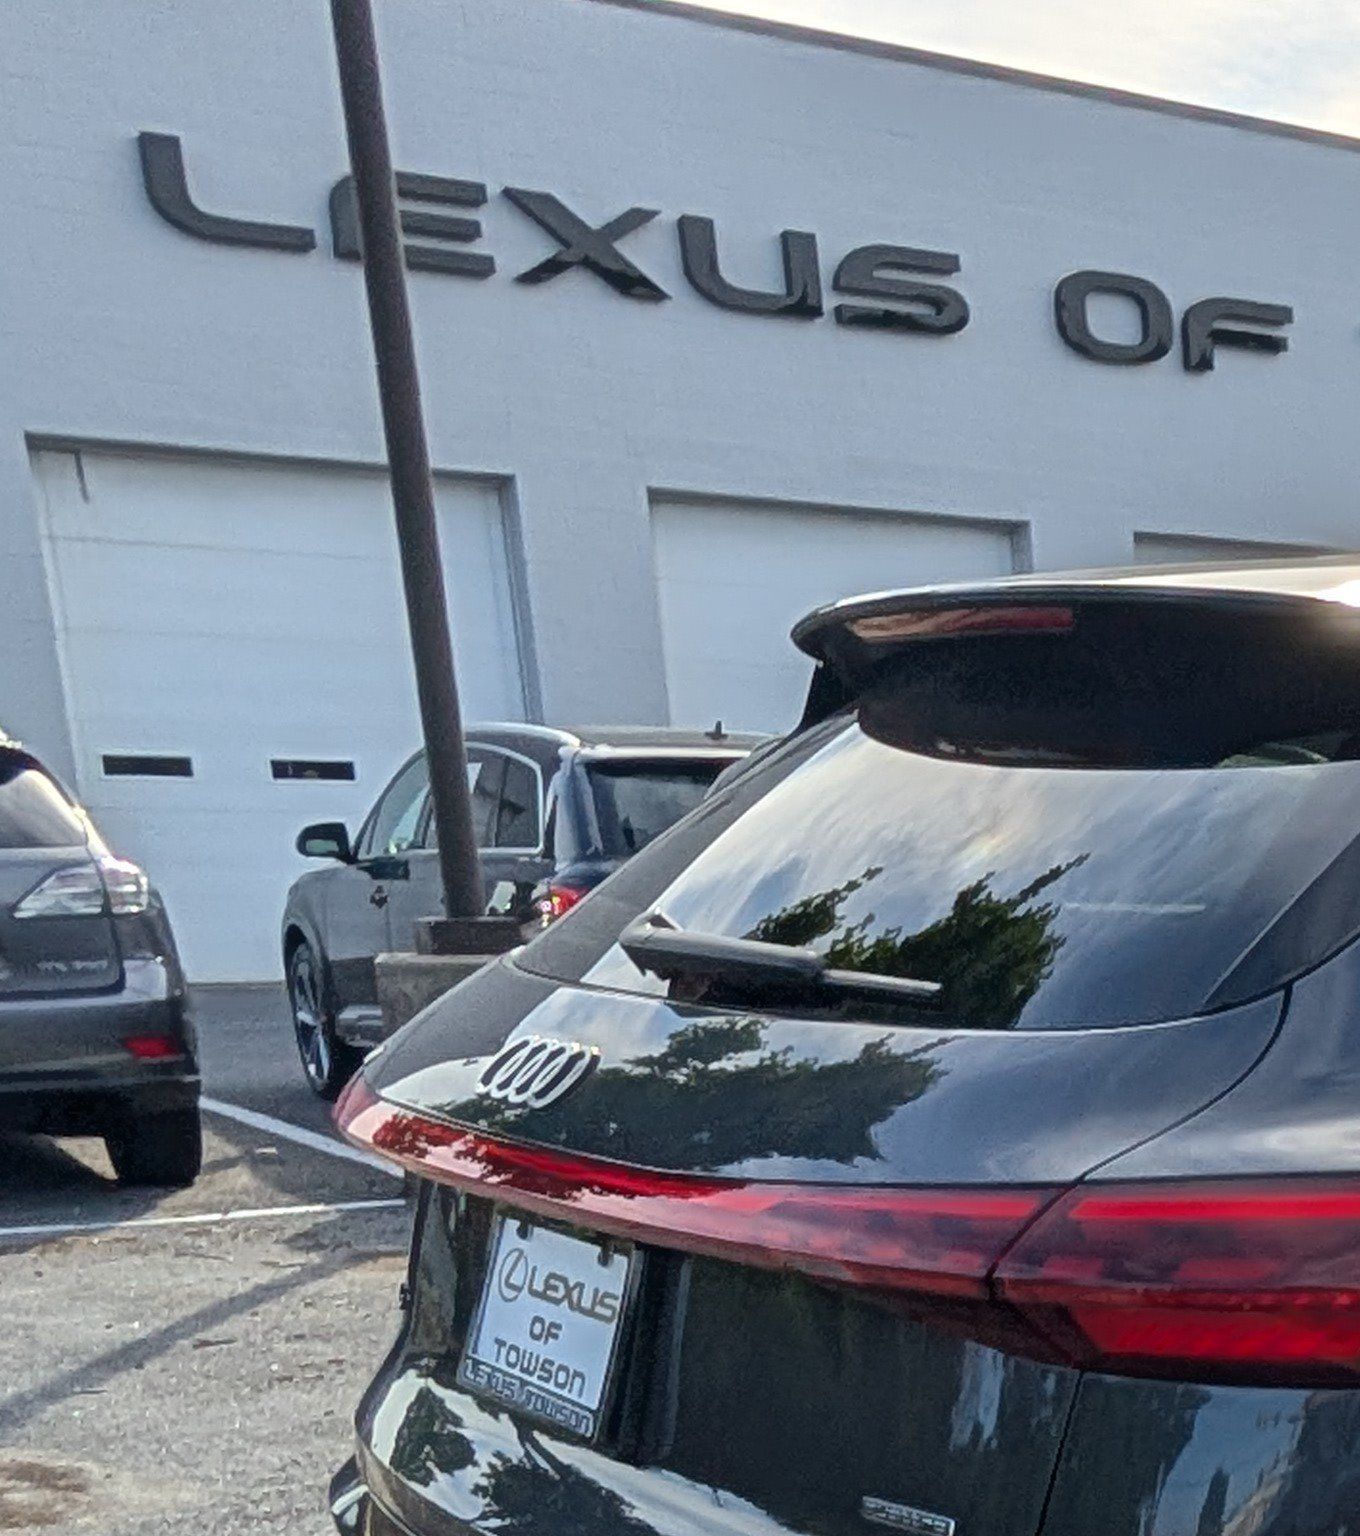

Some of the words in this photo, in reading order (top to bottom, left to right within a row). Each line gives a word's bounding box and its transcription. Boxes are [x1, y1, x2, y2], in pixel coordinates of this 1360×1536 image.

[137, 130, 972, 335] LEXUS
[1053, 269, 1294, 371] OF
[526, 1264, 620, 1324] LEXUS
[528, 1314, 563, 1345] OF
[493, 1337, 586, 1399] TOWSON
